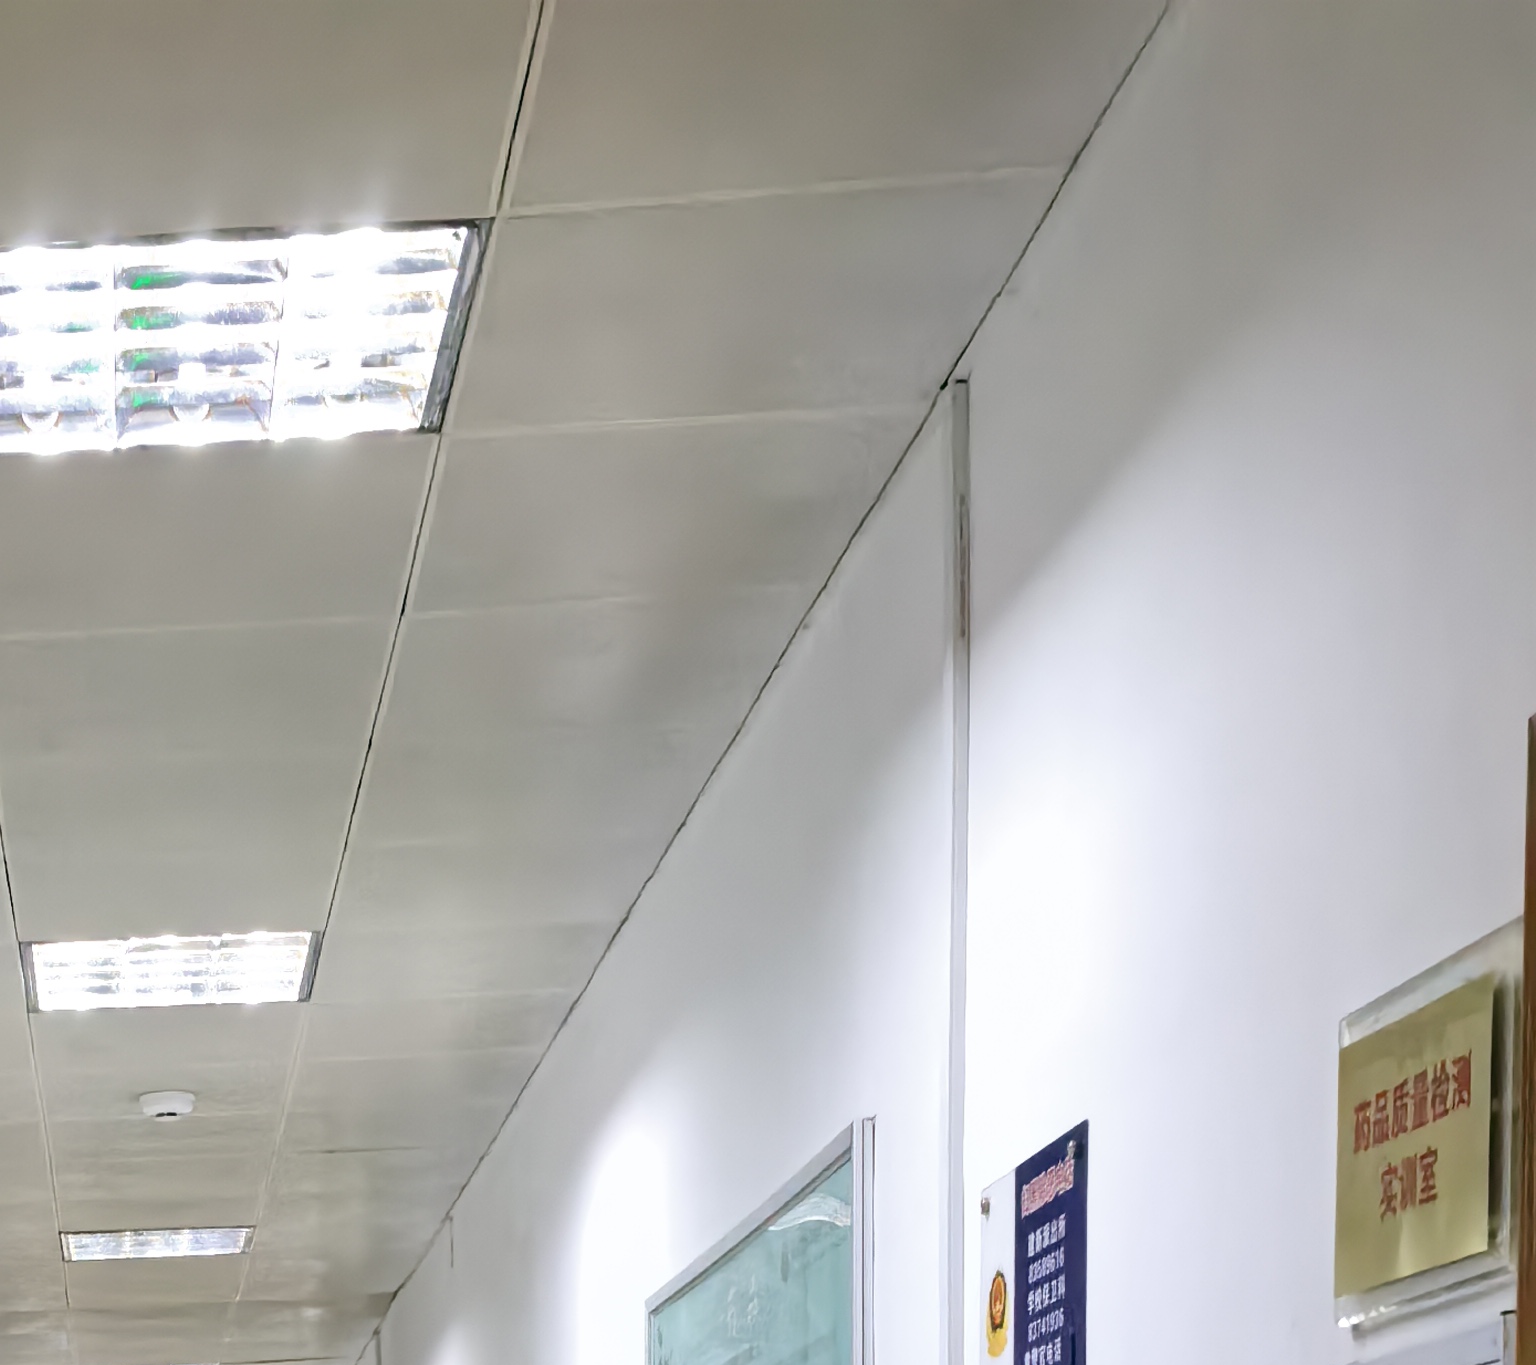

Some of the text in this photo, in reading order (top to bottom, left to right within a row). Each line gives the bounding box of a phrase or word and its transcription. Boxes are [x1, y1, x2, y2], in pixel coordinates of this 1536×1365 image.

[1353, 1048, 1472, 1154] 药品质量检测
[1378, 1146, 1439, 1222] 实训室
